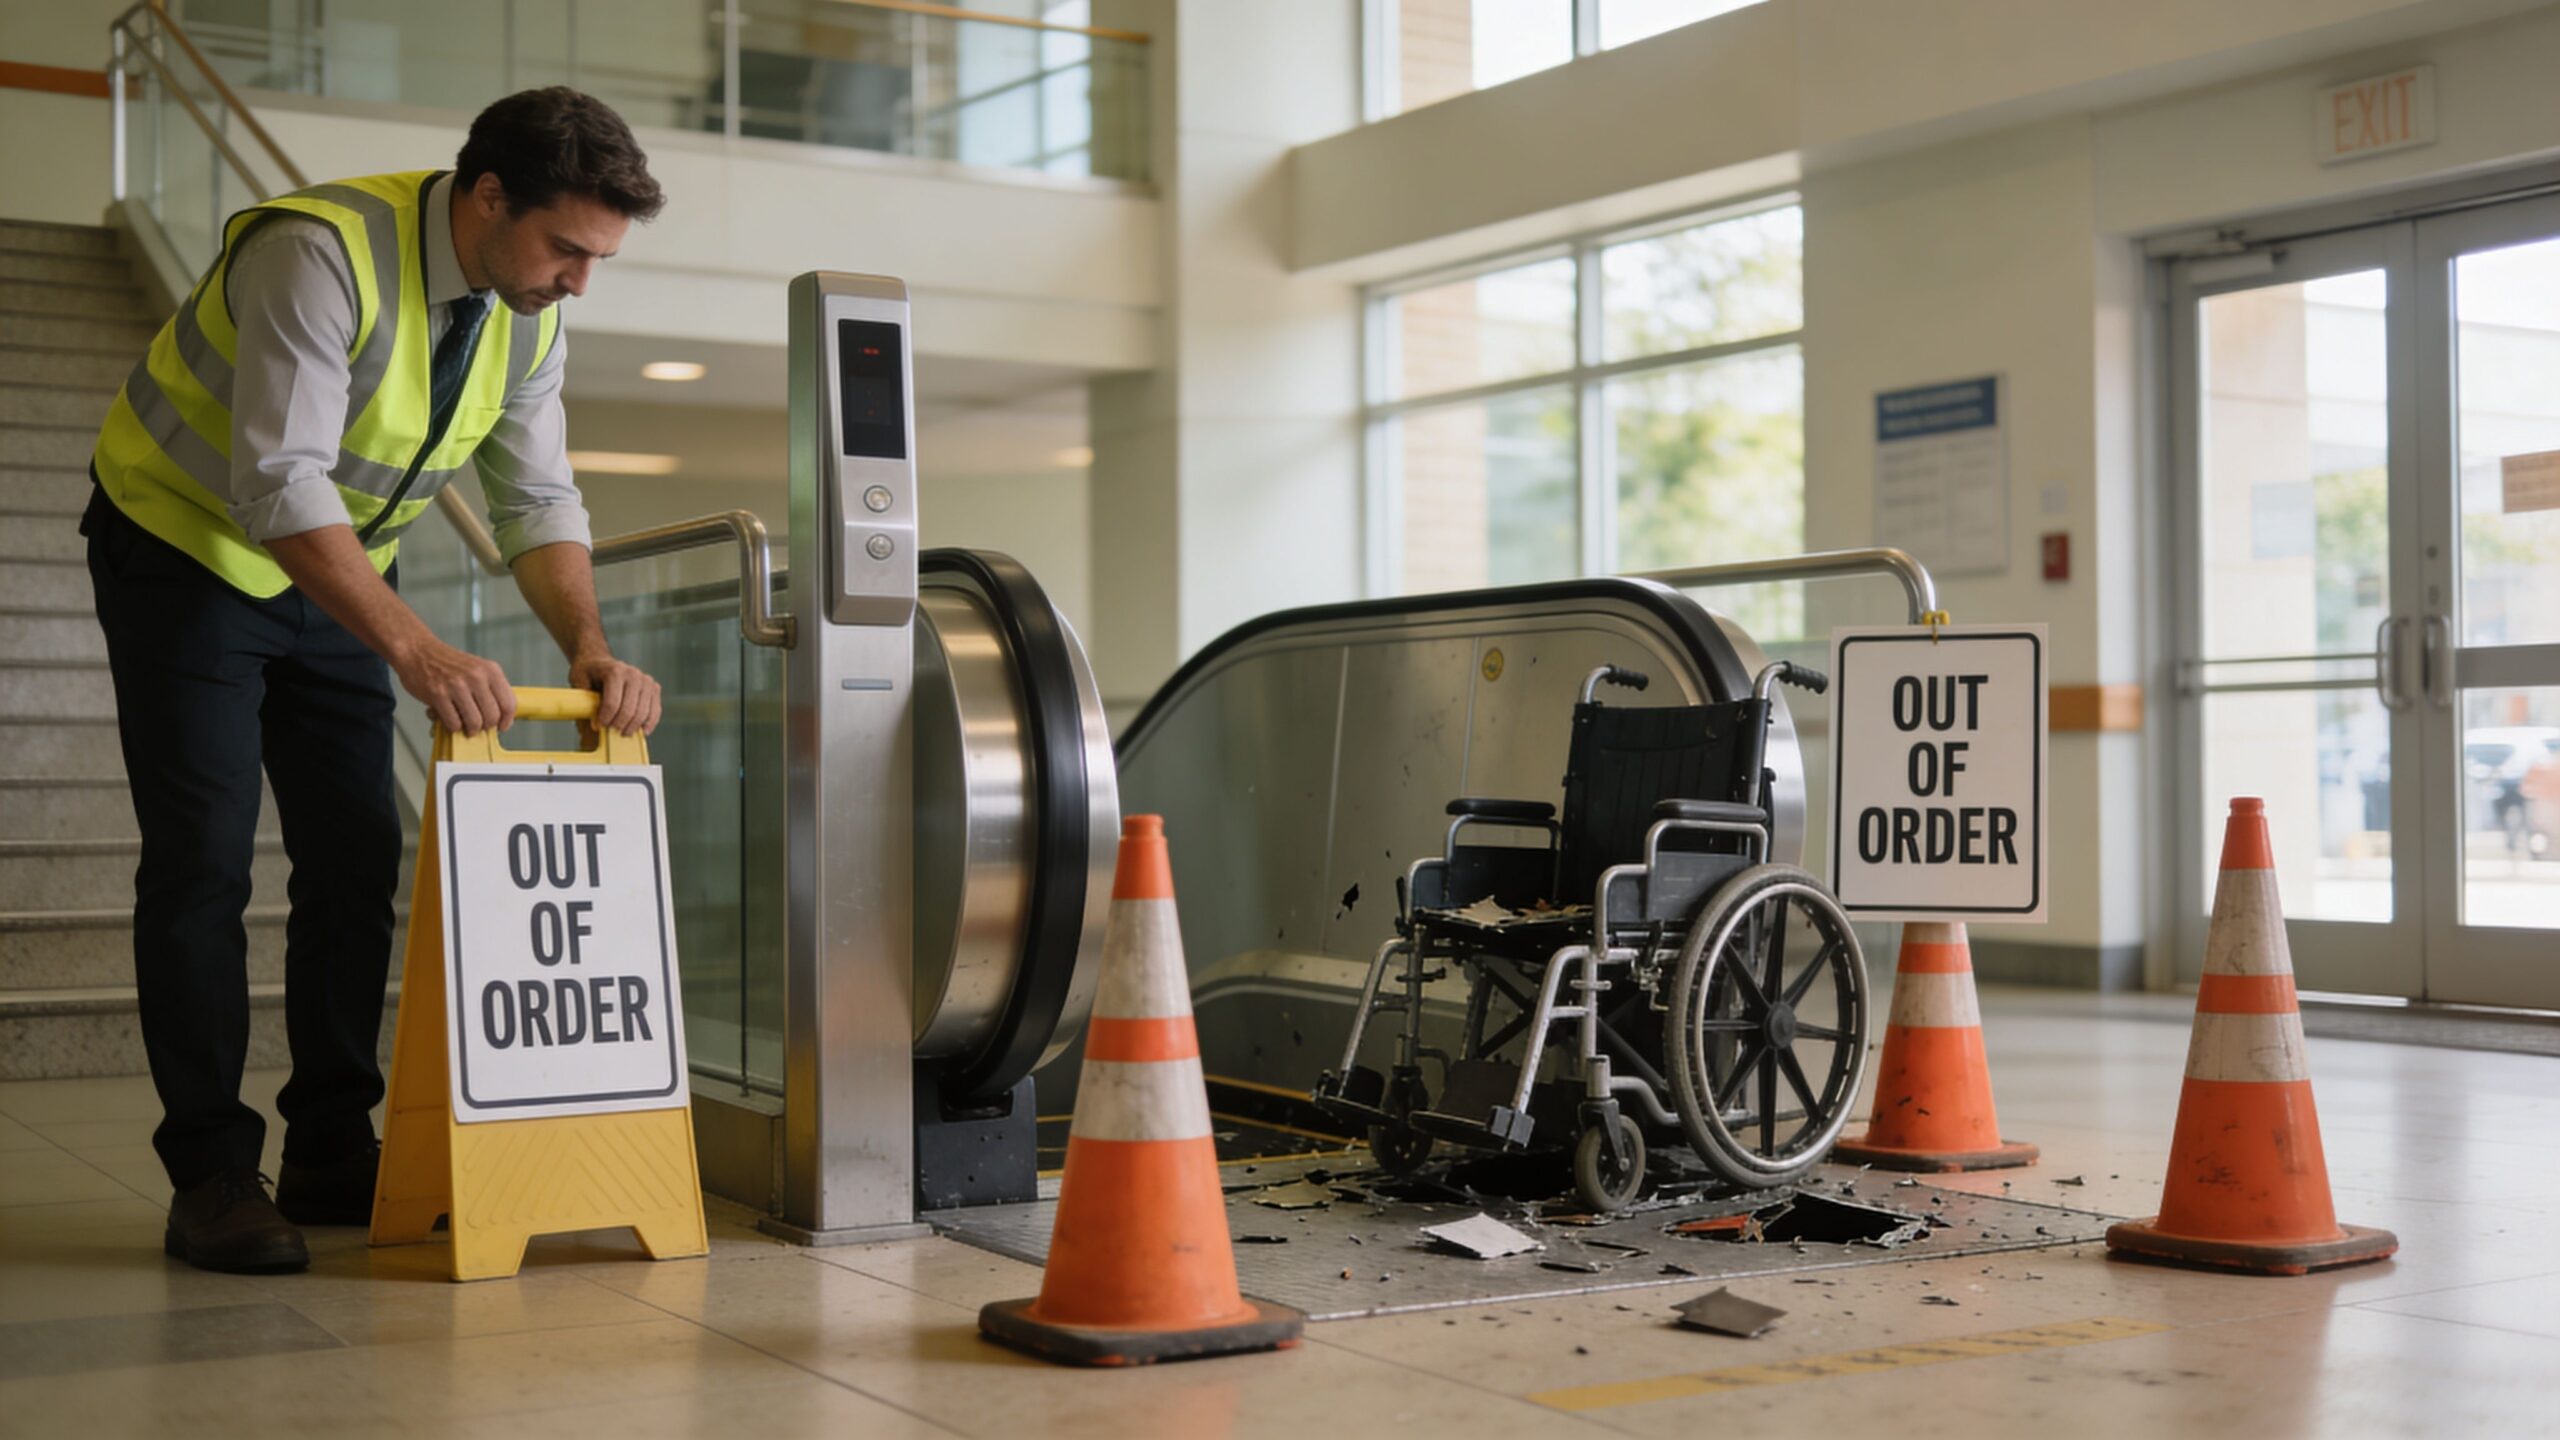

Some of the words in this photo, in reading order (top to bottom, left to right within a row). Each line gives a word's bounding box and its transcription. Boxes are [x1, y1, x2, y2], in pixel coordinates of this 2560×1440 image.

[2332, 73, 2417, 155] EXIT
[1892, 673, 1991, 733] OUT
[1907, 740, 1971, 798] OF
[508, 823, 607, 890] OUT
[1857, 806, 2019, 866] ORDER
[530, 901, 594, 967] OF
[481, 975, 654, 1050] ORDER
